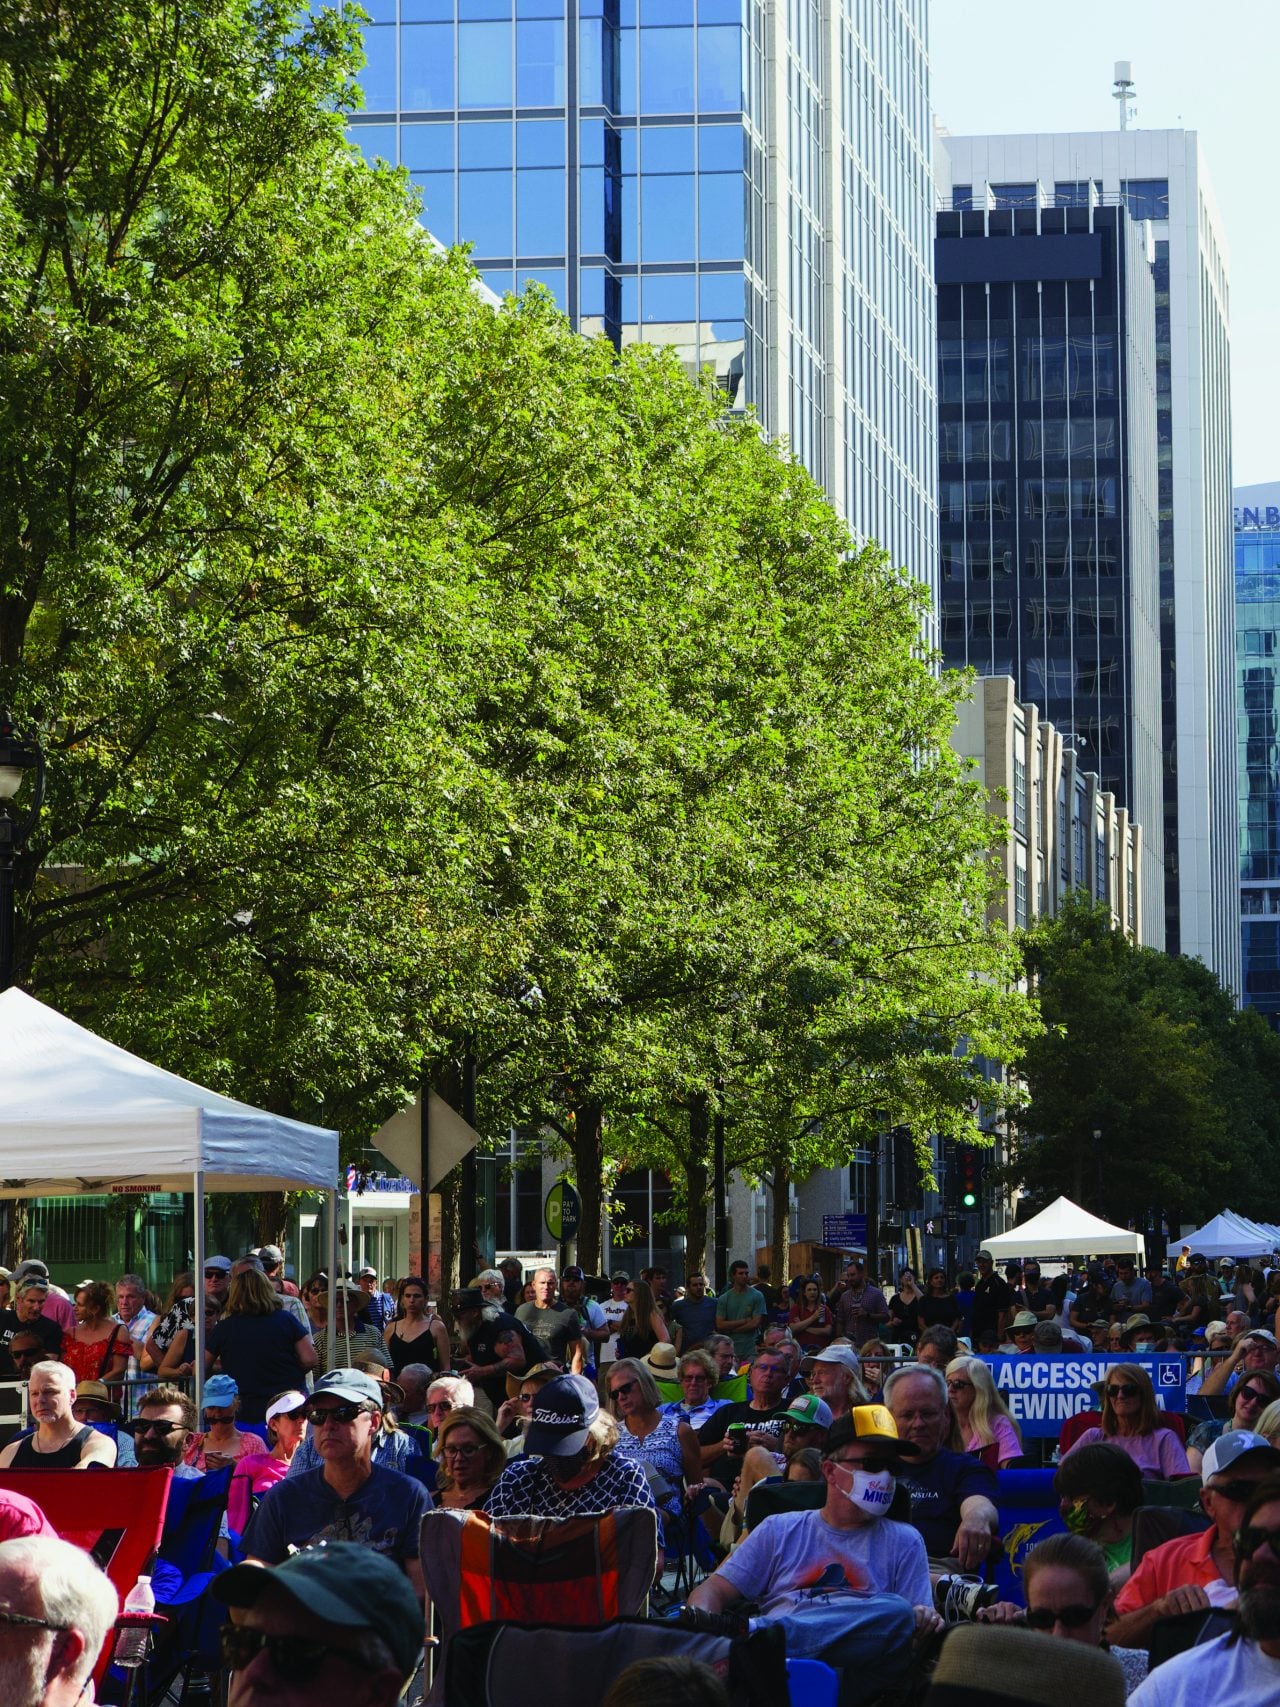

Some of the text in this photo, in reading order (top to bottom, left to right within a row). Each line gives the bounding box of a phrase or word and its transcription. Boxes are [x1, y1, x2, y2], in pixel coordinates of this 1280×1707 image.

[112, 1184, 161, 1193] NO SMOKING
[563, 1200, 574, 1208] PAY
[549, 1201, 560, 1222] P
[563, 1215, 577, 1223] PARK
[1008, 1393, 1091, 1420] EWING
[533, 1408, 580, 1424] Titleist
